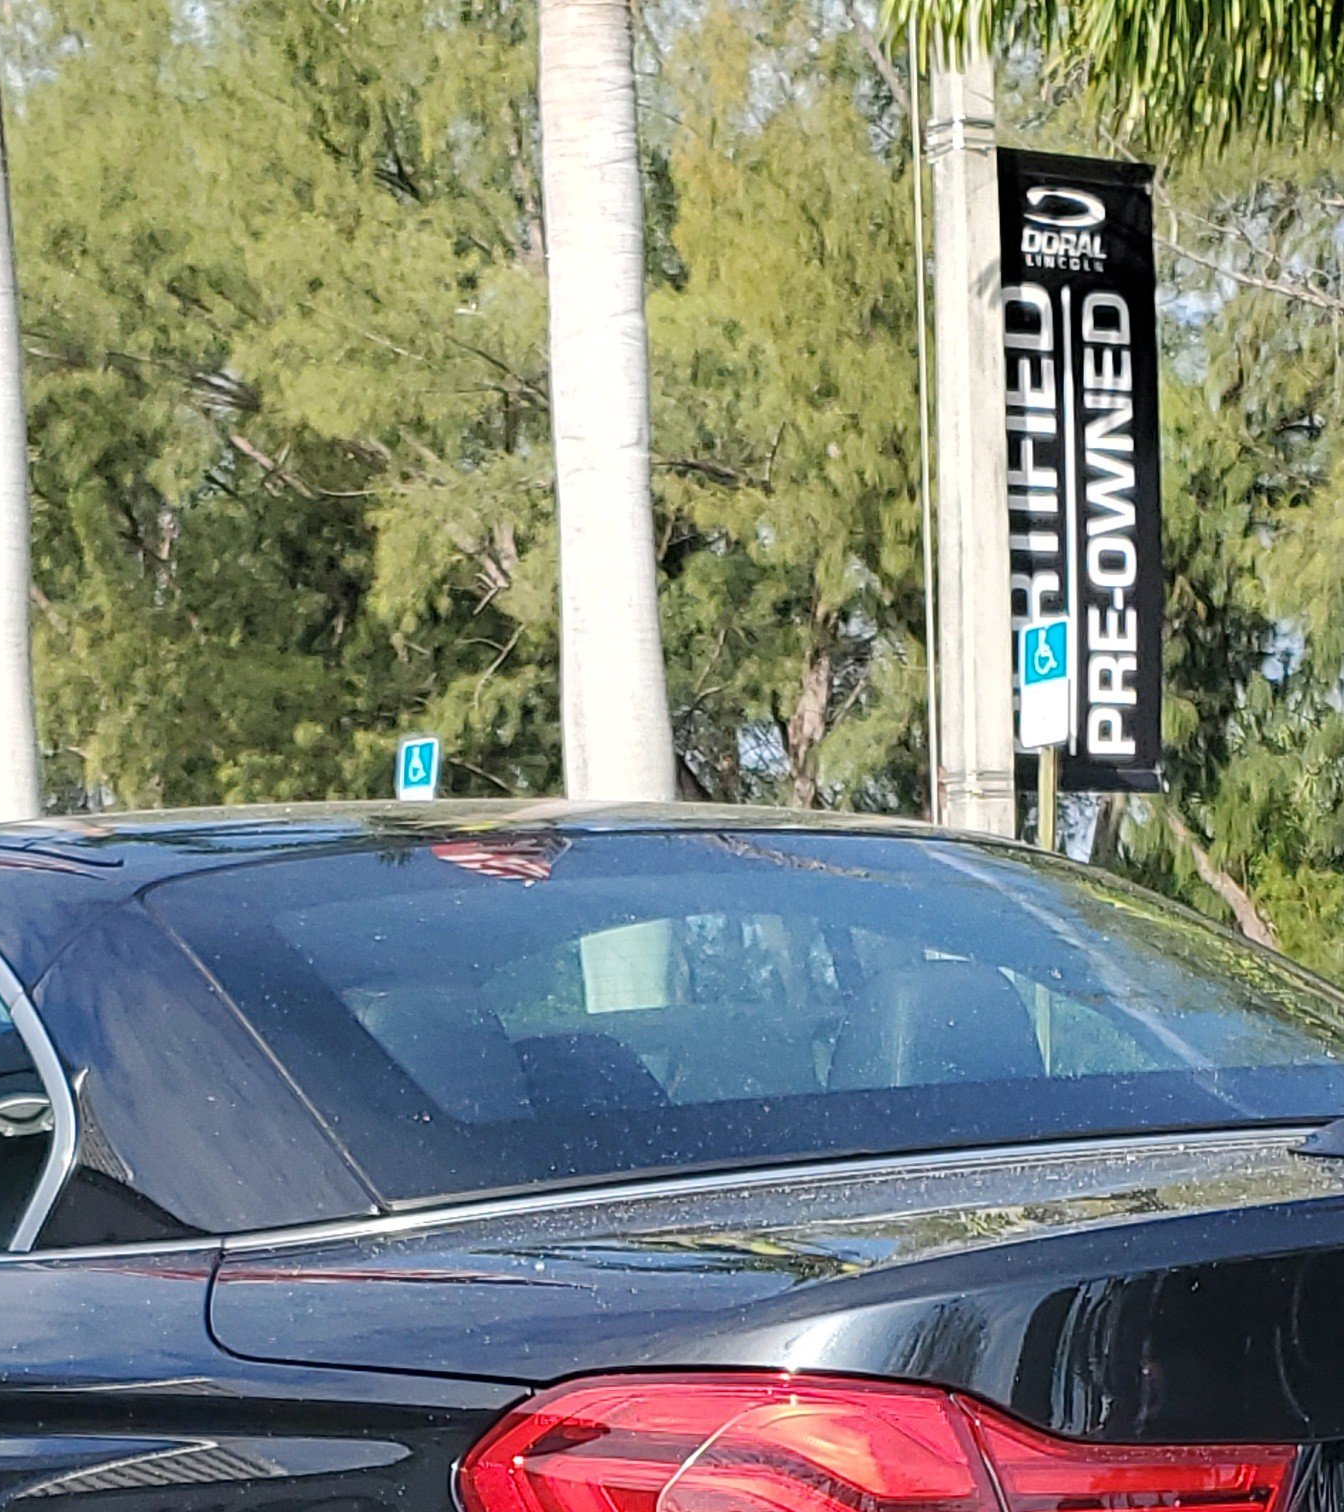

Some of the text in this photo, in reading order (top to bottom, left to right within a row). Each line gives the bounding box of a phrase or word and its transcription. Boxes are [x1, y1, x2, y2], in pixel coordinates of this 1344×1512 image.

[1021, 226, 1107, 259] DORAL
[1025, 253, 1105, 273] LINCOLN
[1002, 283, 1059, 753] RTIFIED
[1082, 293, 1138, 756] PRE-OWNED
